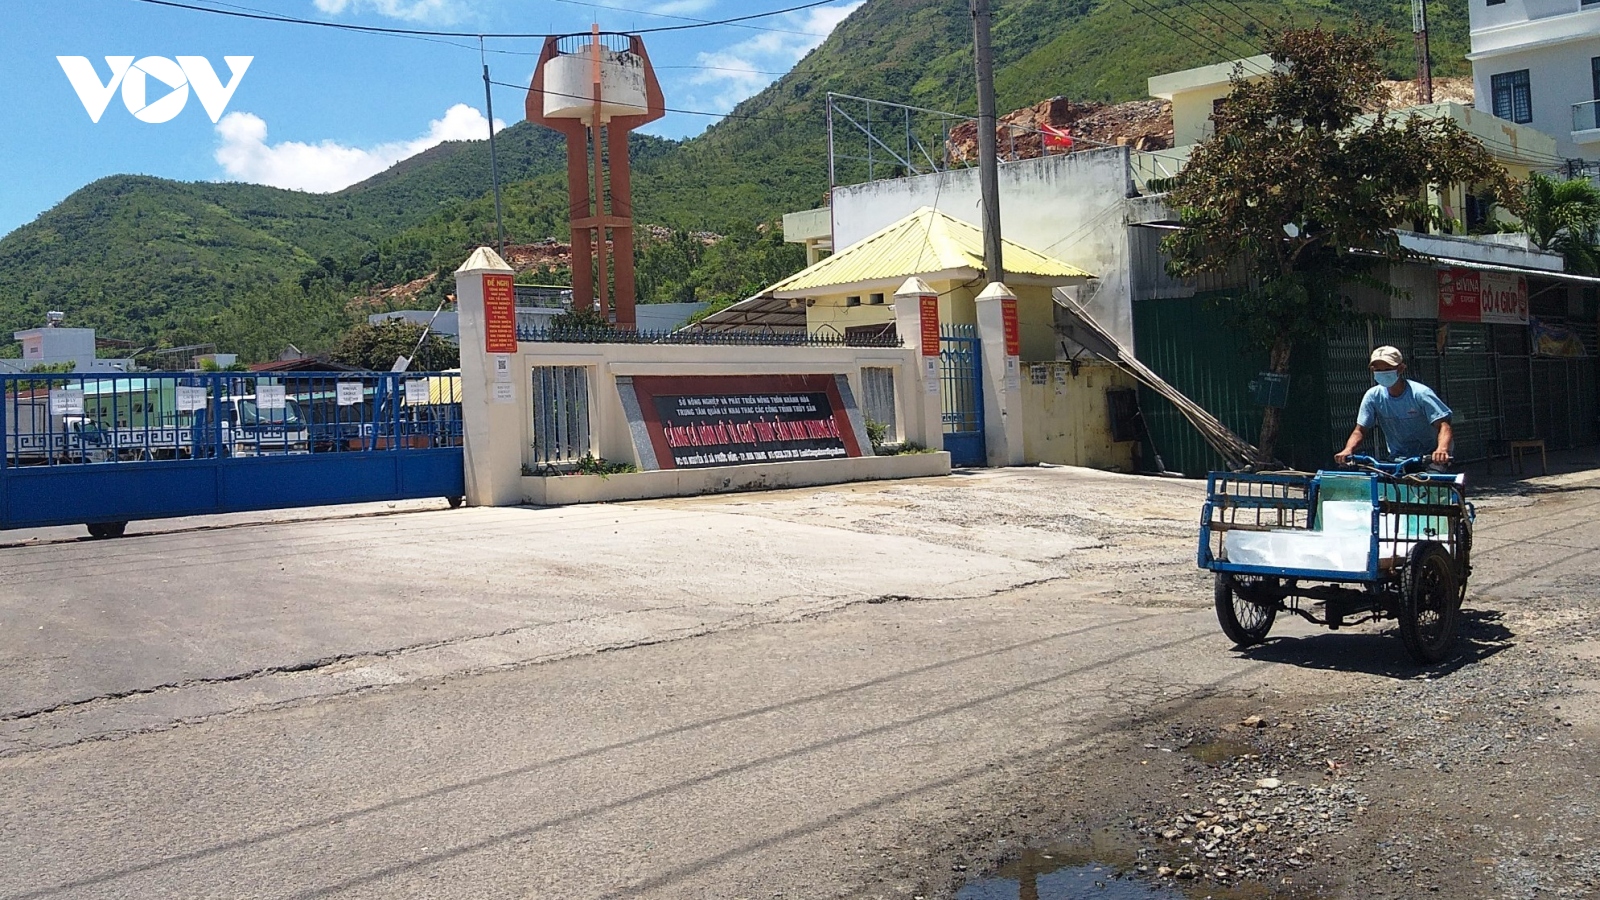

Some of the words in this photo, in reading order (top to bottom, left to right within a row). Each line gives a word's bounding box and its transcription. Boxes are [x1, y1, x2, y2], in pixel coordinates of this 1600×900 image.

[1455, 277, 1479, 293] BIVINA
[1460, 295, 1476, 303] EXPORT
[1495, 290, 1499, 313] 4
[678, 396, 686, 406] SỞ
[687, 397, 702, 406] NÔNG
[702, 396, 719, 407] NGHIỆP
[720, 396, 728, 405] VÀ
[728, 396, 741, 405] PHÁT
[741, 395, 756, 405] TRIỂN
[756, 396, 770, 404] NÔNG
[770, 395, 783, 404] THÔN
[783, 395, 799, 403] KHÁNH
[676, 408, 695, 416] TRUNG
[695, 407, 706, 416] TÂM
[707, 405, 721, 416] QUẢN
[728, 407, 740, 415] KHAI
[754, 405, 765, 414] CÁC
[765, 405, 778, 413] CÔNG
[664, 420, 690, 448] CẢNG
[686, 421, 701, 447] CÁ
[698, 420, 718, 446] HÒN
[726, 419, 741, 444] VÀ
[736, 420, 757, 447] CHỢ
[772, 415, 791, 441] SẢN
[787, 421, 808, 440] NAM
[803, 419, 831, 439] TRUNG
